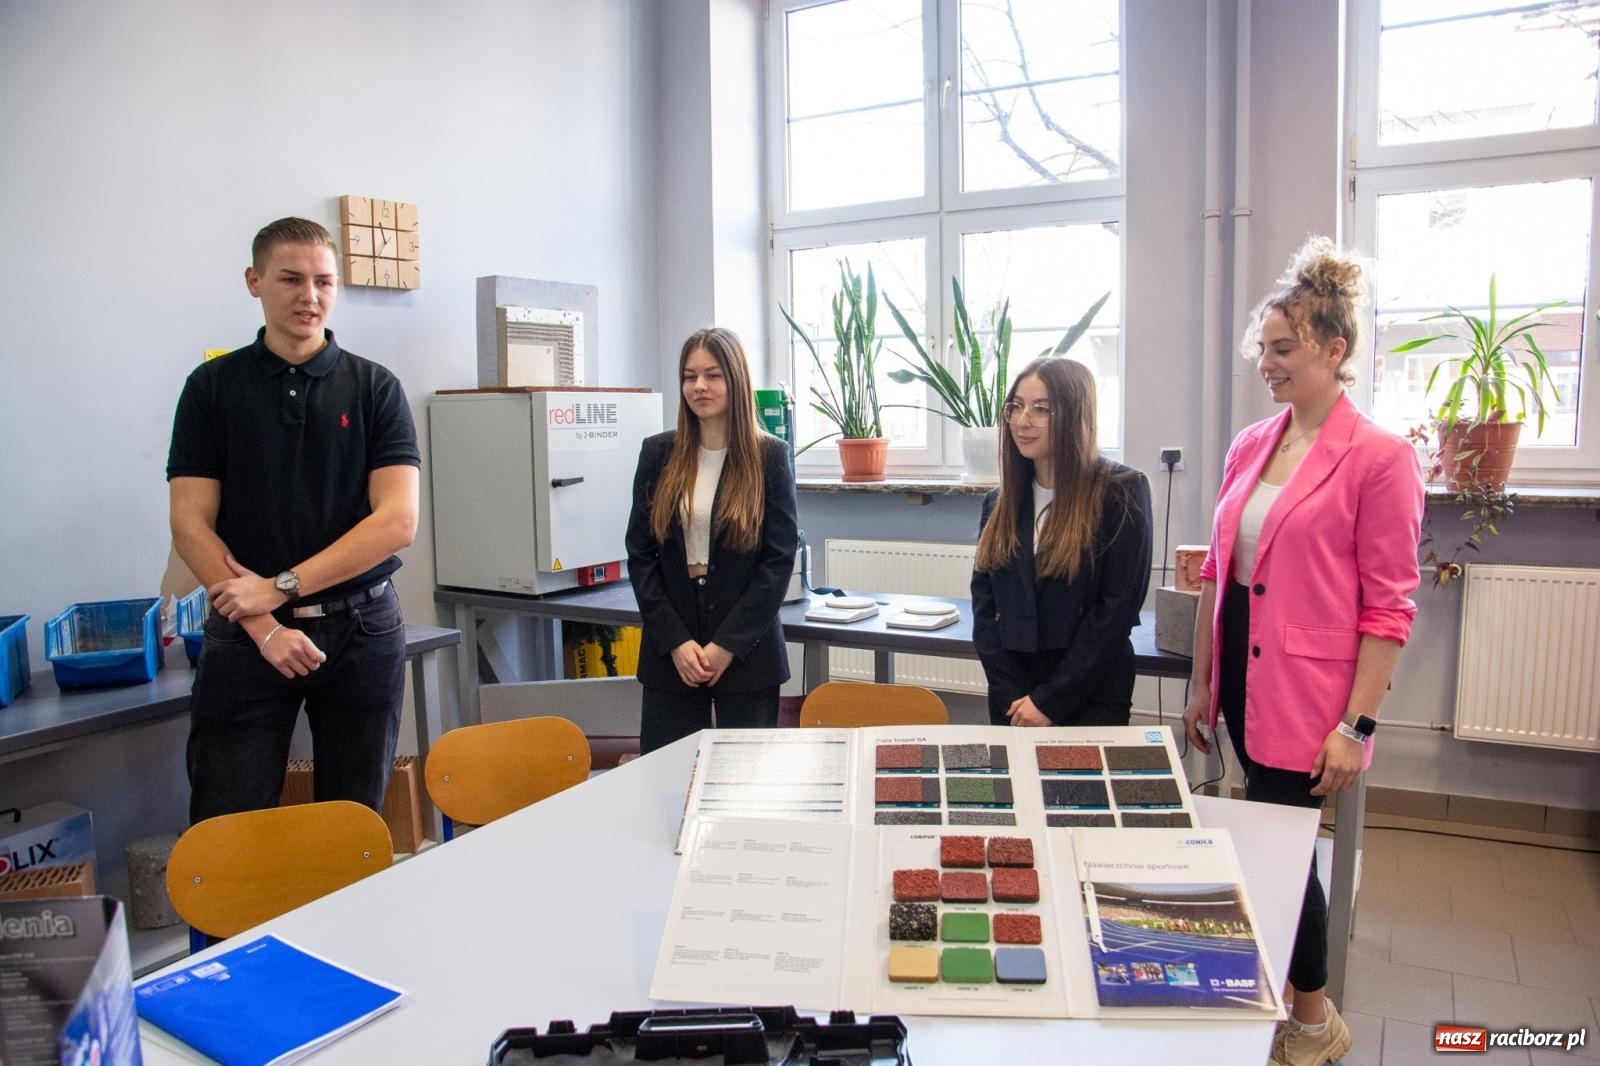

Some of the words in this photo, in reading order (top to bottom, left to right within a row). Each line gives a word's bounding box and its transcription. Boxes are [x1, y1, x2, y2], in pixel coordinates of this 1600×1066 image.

[549, 403, 617, 425] redLINE
[1083, 860, 1144, 870] Nawierzchnie
[1147, 863, 1189, 871] sportowe
[1225, 978, 1256, 987] BASF
